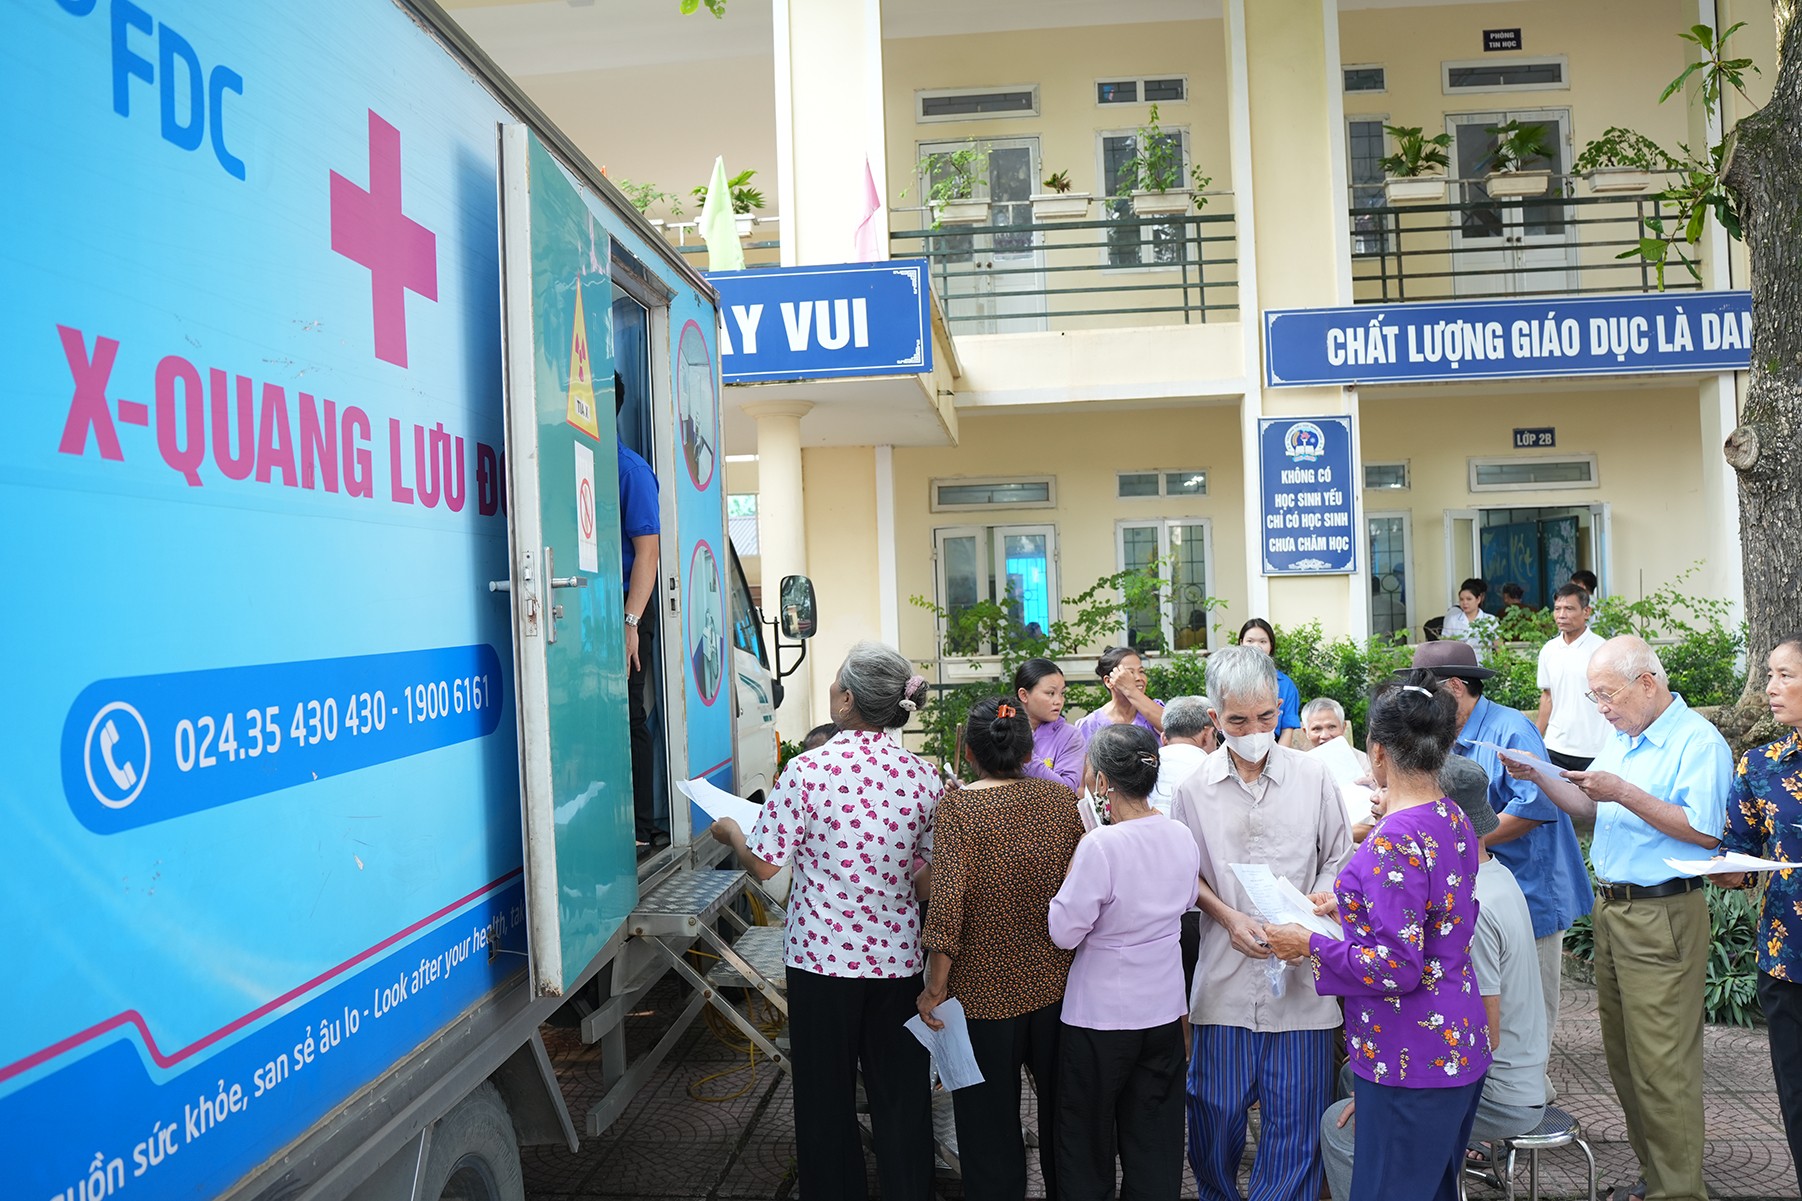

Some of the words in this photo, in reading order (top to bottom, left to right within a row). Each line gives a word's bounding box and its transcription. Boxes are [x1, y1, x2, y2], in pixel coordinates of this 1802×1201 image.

[1502, 40, 1517, 48] HỌC
[780, 297, 869, 351] VUI
[1327, 313, 1399, 366] CHẤT
[1407, 319, 1504, 369] LƯỢNG
[1511, 311, 1580, 359] GIÁO
[1589, 316, 1649, 362] DỤC
[1656, 305, 1694, 353] LÀ
[56, 323, 373, 499] X-QUANG
[389, 417, 466, 512] LƯU
[1517, 430, 1537, 446] LỚP
[1539, 432, 1553, 445] 2B
[1281, 466, 1315, 484] KHÔNG
[1318, 465, 1332, 483] CÓ
[1274, 493, 1295, 510] HỌC
[1297, 491, 1322, 507] SINH
[1323, 487, 1343, 506] YẾU
[1266, 509, 1284, 529] CHỈ
[1285, 510, 1300, 528] CÓ
[1301, 512, 1322, 531] HỌC
[1323, 511, 1349, 527] SINH
[1268, 536, 1296, 552] CHƯA
[1297, 533, 1327, 552] CHĂM
[1328, 536, 1350, 553] HỌC
[175, 705, 281, 772] 024.35
[290, 697, 338, 747] 430
[345, 690, 387, 736] 430
[404, 680, 449, 724] 1900
[453, 674, 490, 715] 6161
[50, 1151, 125, 1201] uồn
[133, 1120, 179, 1177] sức
[184, 1078, 248, 1143] khỏe,
[253, 1052, 289, 1098] san
[293, 1025, 315, 1071] sẻ
[319, 1018, 341, 1054] âu
[344, 1006, 360, 1038] lo
[374, 972, 409, 1019] Look
[411, 954, 443, 994] after
[444, 936, 471, 979] your
